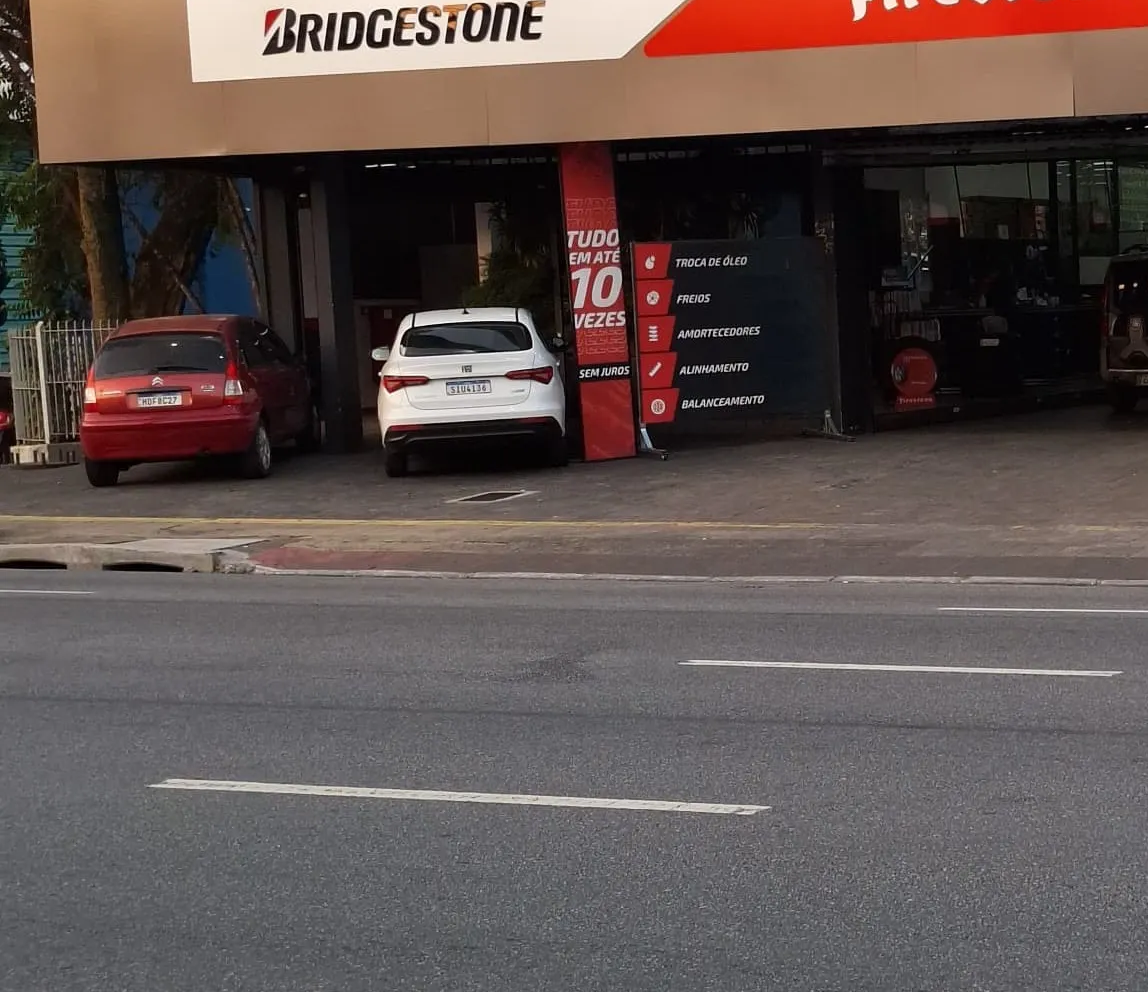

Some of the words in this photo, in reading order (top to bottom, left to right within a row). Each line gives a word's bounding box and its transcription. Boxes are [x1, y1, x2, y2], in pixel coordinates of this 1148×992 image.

[262, 0, 546, 56] BRIDGESTONE
[567, 228, 620, 248] TUDO
[569, 251, 592, 265] EM
[592, 246, 621, 264] ATÉ
[675, 257, 706, 268] TROCA
[708, 257, 721, 267] DE
[723, 254, 748, 267] ÓLEO
[571, 266, 623, 309] 10
[676, 293, 711, 304] FREIOS
[573, 310, 626, 329] VEZES
[677, 326, 761, 340] AMORTECEDORES
[578, 366, 601, 379] SEM
[600, 365, 630, 377] JUROS
[679, 362, 749, 375] ALINHAMENTO
[681, 394, 765, 409] BALANCEAMENTO
